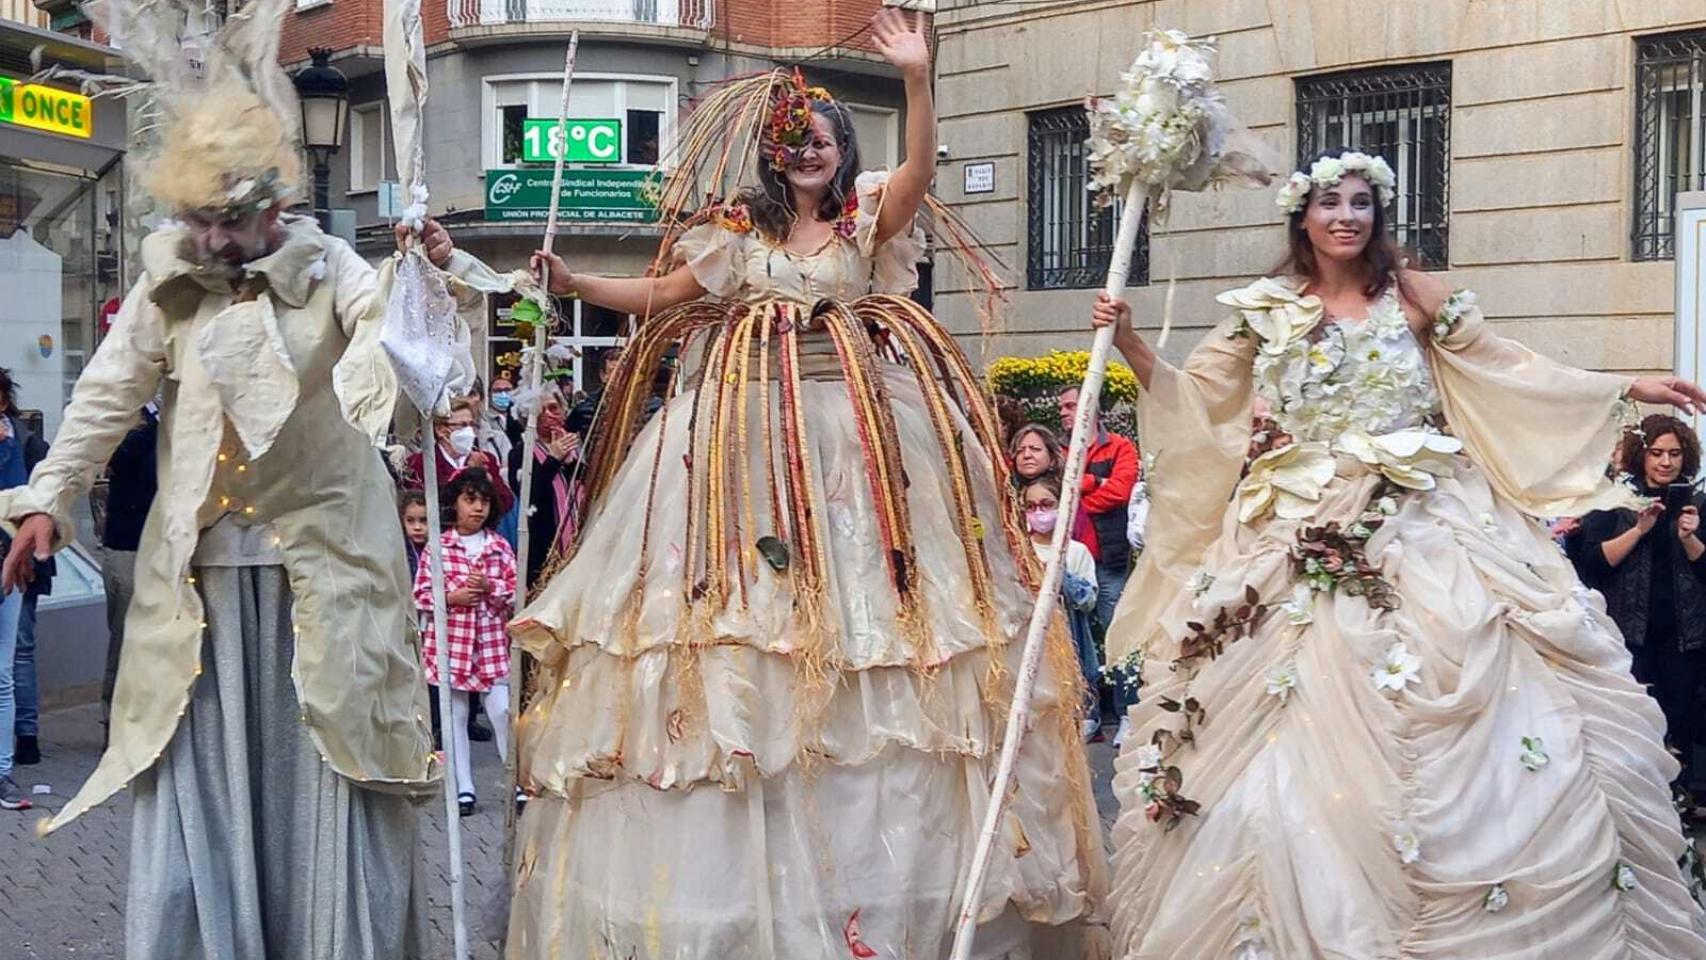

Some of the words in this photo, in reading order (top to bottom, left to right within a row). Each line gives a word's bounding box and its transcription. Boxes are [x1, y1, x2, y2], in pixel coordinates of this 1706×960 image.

[22, 90, 83, 129] ONCE
[525, 125, 615, 158] 18°C
[526, 178, 555, 188] Centr
[560, 188, 572, 198] de
[574, 188, 632, 198] Funcionarios
[501, 209, 529, 218] UNIÓN
[530, 210, 582, 218] PRONCIAL
[597, 211, 644, 219] ALBACETE
